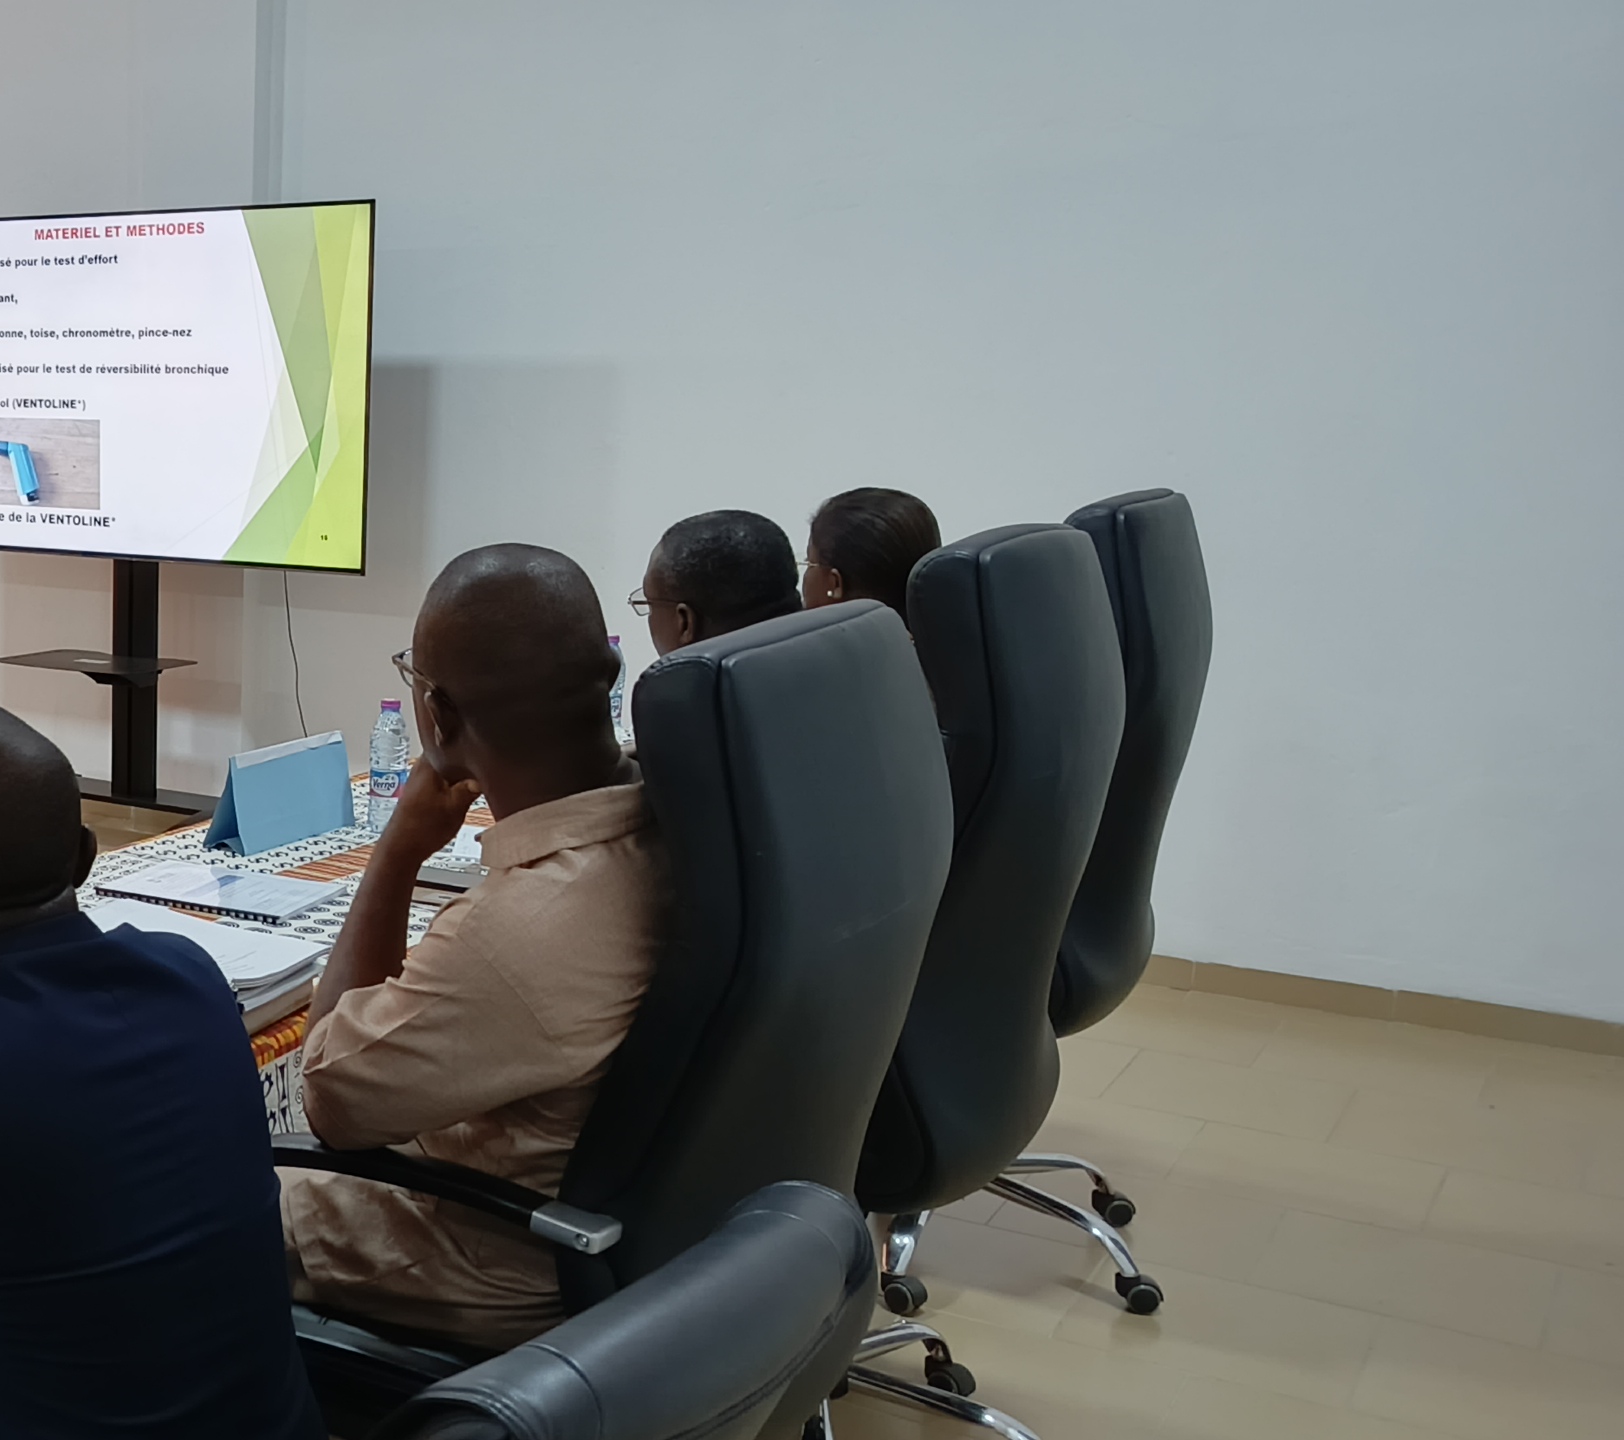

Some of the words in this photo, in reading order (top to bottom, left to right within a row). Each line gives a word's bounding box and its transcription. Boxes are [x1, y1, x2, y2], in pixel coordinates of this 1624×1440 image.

[34, 226, 101, 241] MATERIEL
[104, 225, 123, 239] ET
[126, 221, 205, 237] METHODES
[14, 258, 39, 270] pour
[40, 255, 52, 267] le
[53, 255, 76, 266] test
[77, 253, 119, 266] d'effort
[29, 327, 60, 341] toise,
[61, 327, 135, 340] chronomètre,
[137, 326, 193, 340] pince-nez
[16, 365, 40, 376] pour
[42, 363, 53, 374] le
[54, 364, 77, 374] test
[78, 363, 93, 374] de
[95, 363, 162, 375] réversibilité
[164, 363, 230, 377] bronchique
[7, 512, 23, 523] de
[25, 512, 37, 524] la
[372, 778, 396, 791] Verna
